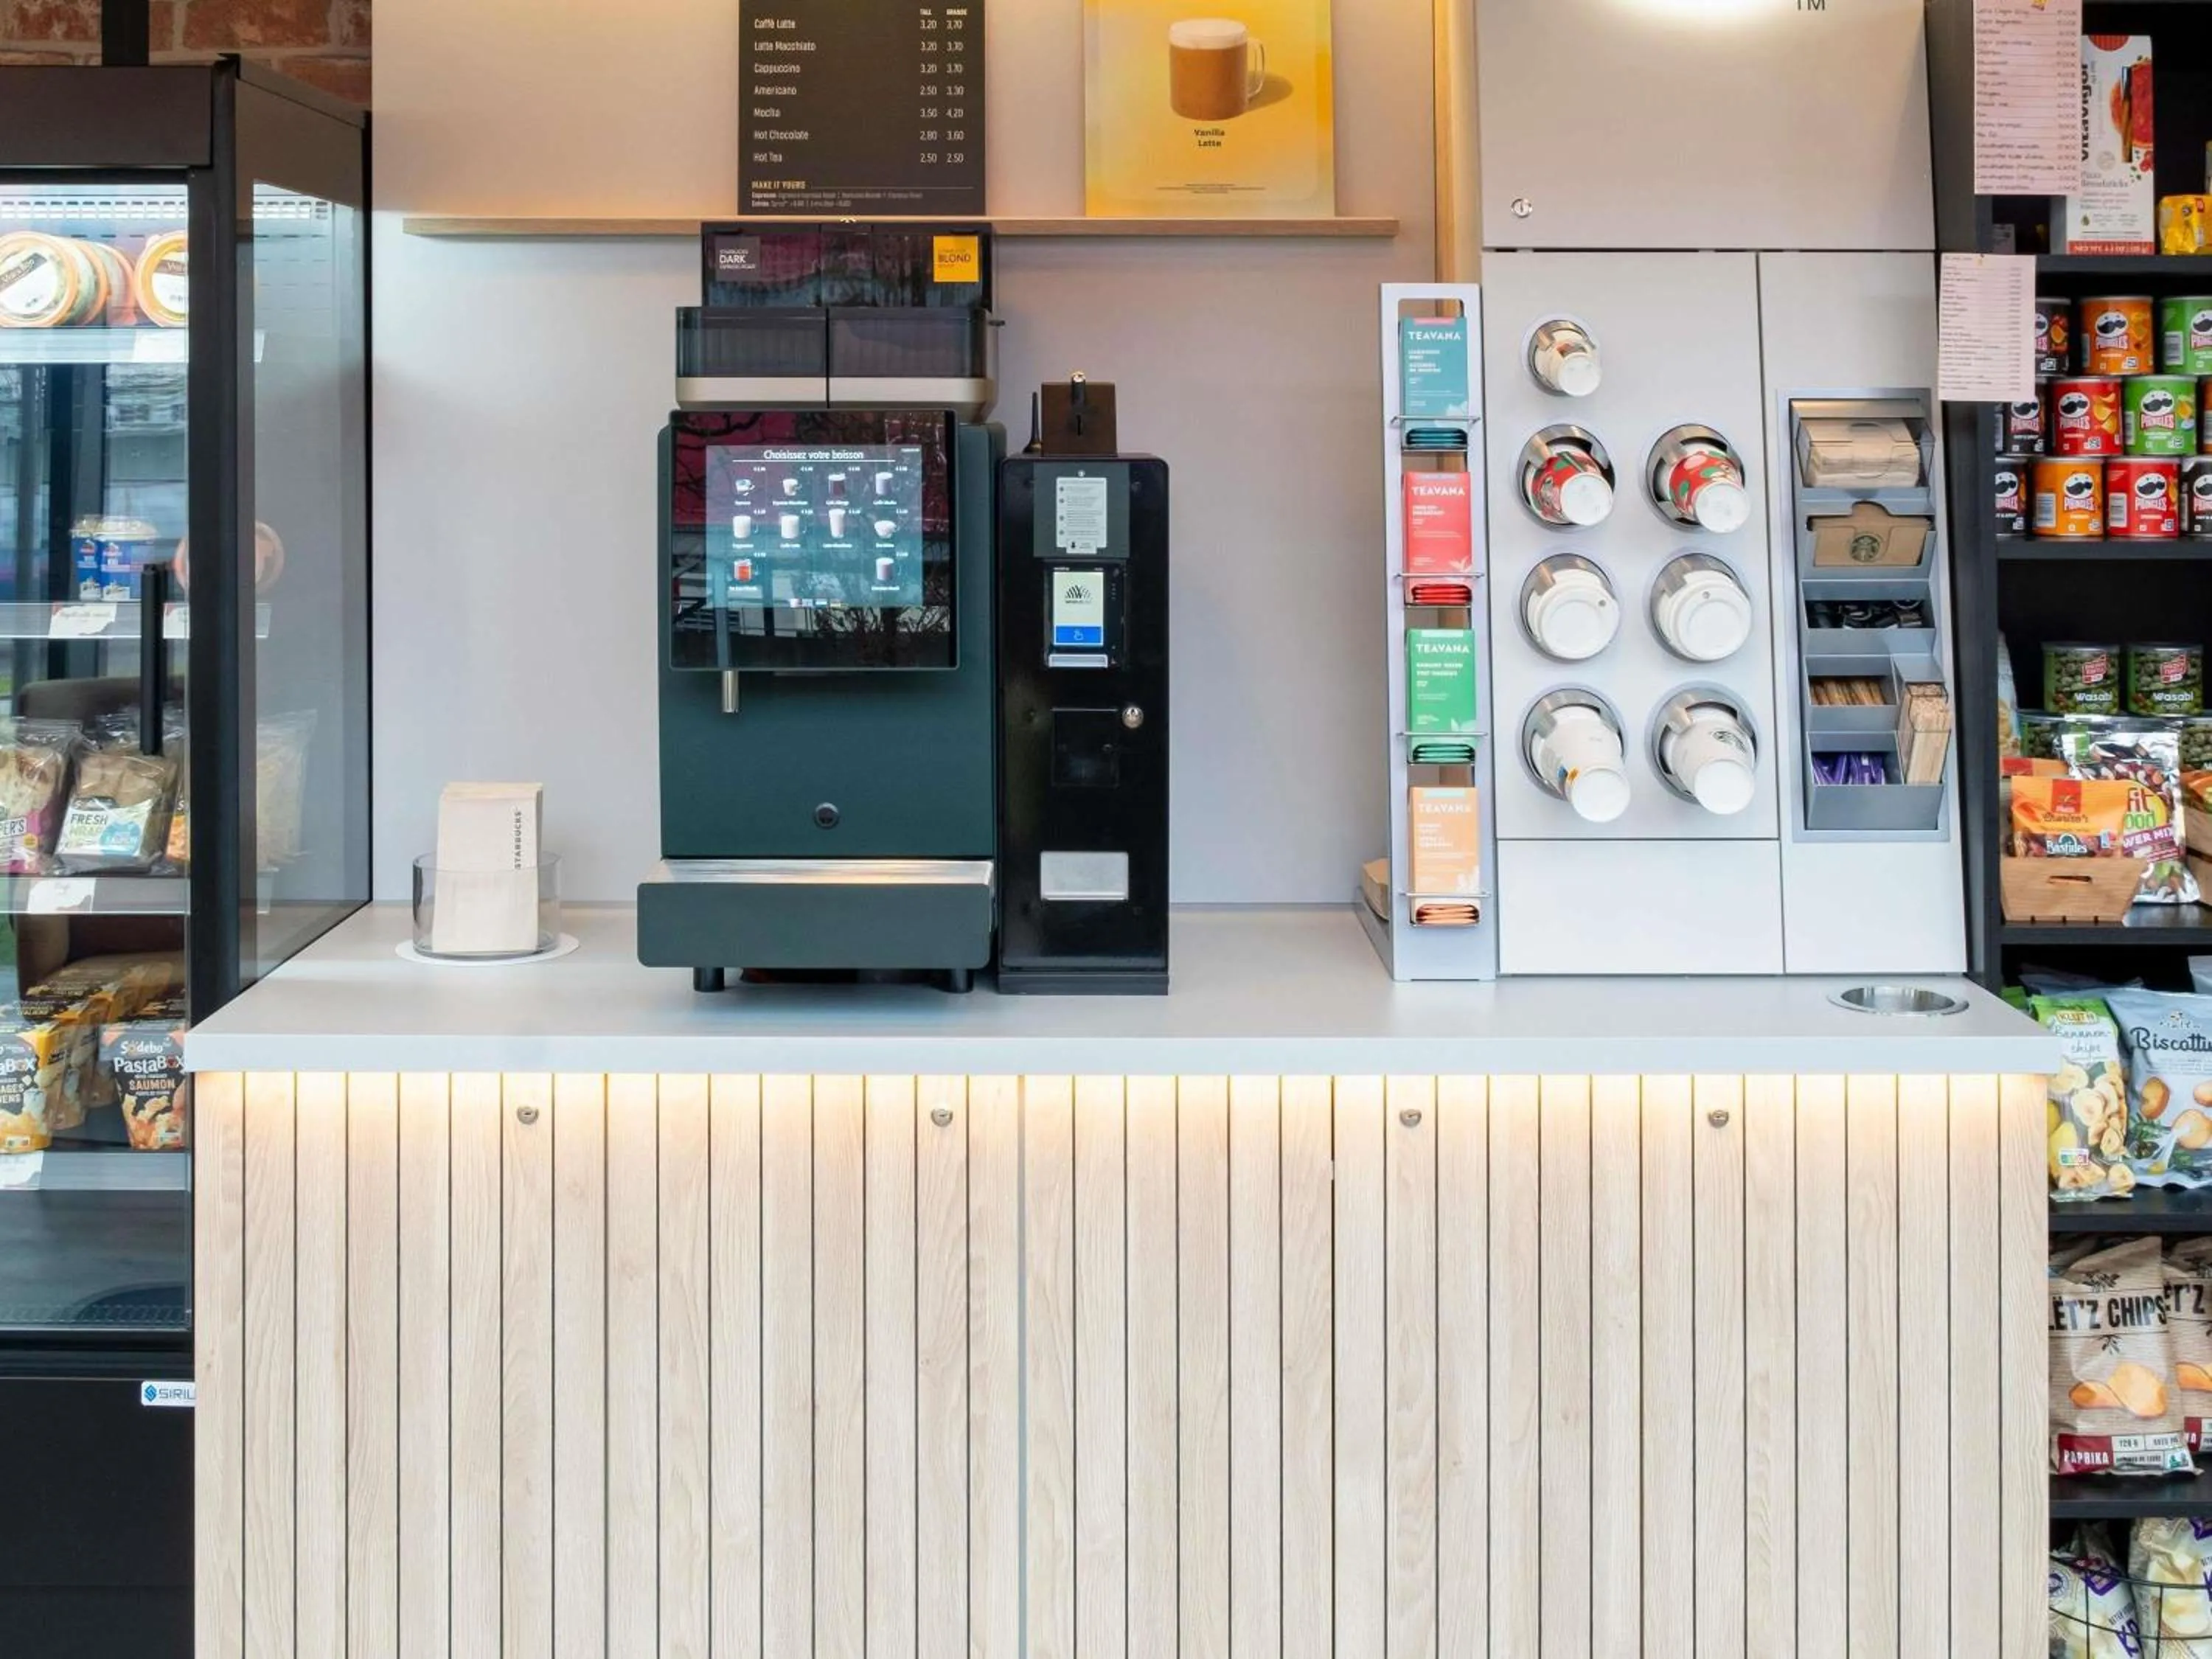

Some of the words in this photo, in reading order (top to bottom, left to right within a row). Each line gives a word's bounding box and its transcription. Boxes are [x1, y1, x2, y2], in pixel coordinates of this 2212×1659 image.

[775, 41, 816, 51] Macchiato
[754, 63, 801, 74] Cappuccino
[754, 85, 797, 95] Americano
[754, 130, 768, 139] Hot
[769, 130, 809, 140] Chocolate
[1194, 128, 1225, 136] Vanilla
[1197, 139, 1222, 147] Latte
[753, 152, 768, 162] Hot
[919, 153, 937, 163] 2.50
[720, 254, 746, 263] DARK
[1408, 330, 1461, 341] TEAVANA
[764, 450, 806, 459] Choisissez
[808, 451, 830, 459] votre
[832, 450, 864, 459] boisson
[1411, 486, 1466, 496] TEAVANA
[1416, 644, 1470, 654] TEAVANA
[2074, 691, 2112, 701] Wasabi
[2153, 691, 2194, 701] Wasabi
[1418, 803, 1472, 814] TEAVANA
[70, 813, 108, 826] FRESH
[514, 811, 522, 870] STARBUCKS
[129, 1079, 175, 1091] SAUMON
[2107, 1295, 2167, 1328] CHIPS
[2064, 1450, 2110, 1465] PAPRIKA
